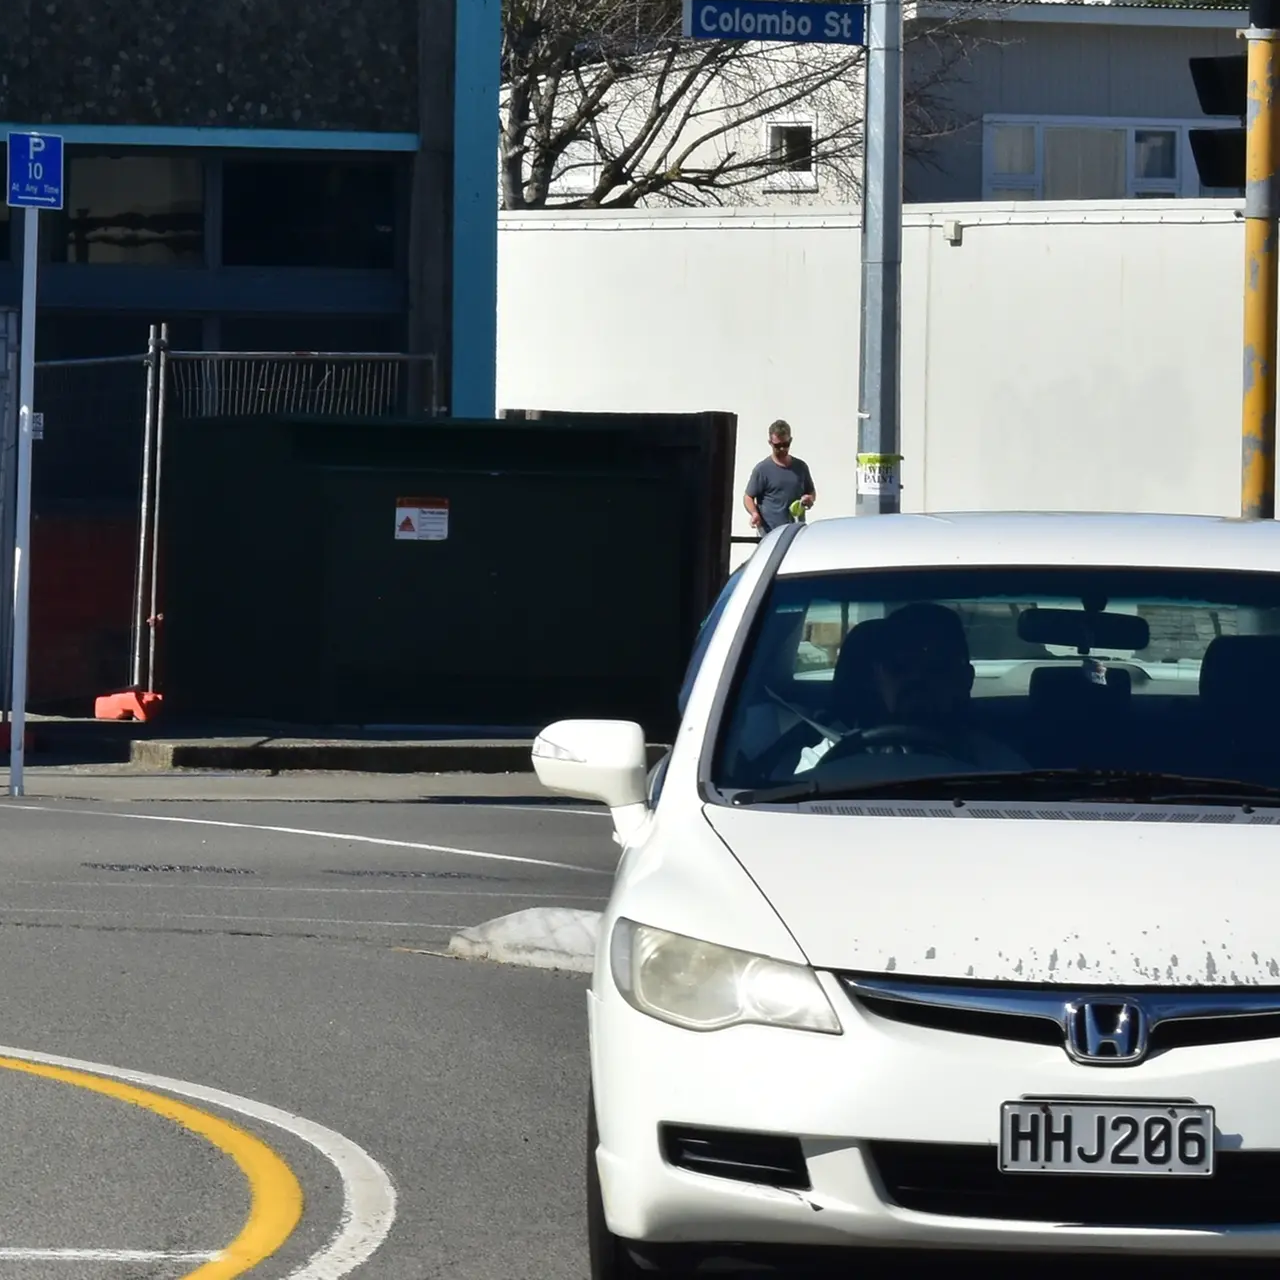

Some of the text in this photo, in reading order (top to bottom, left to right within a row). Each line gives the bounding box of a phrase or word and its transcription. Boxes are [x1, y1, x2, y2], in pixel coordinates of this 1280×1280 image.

[700, 5, 852, 38] Colombo St
[29, 137, 45, 159] P
[28, 162, 43, 180] 10
[864, 474, 894, 484] PAINT
[1010, 1113, 1207, 1166] HHJ206
